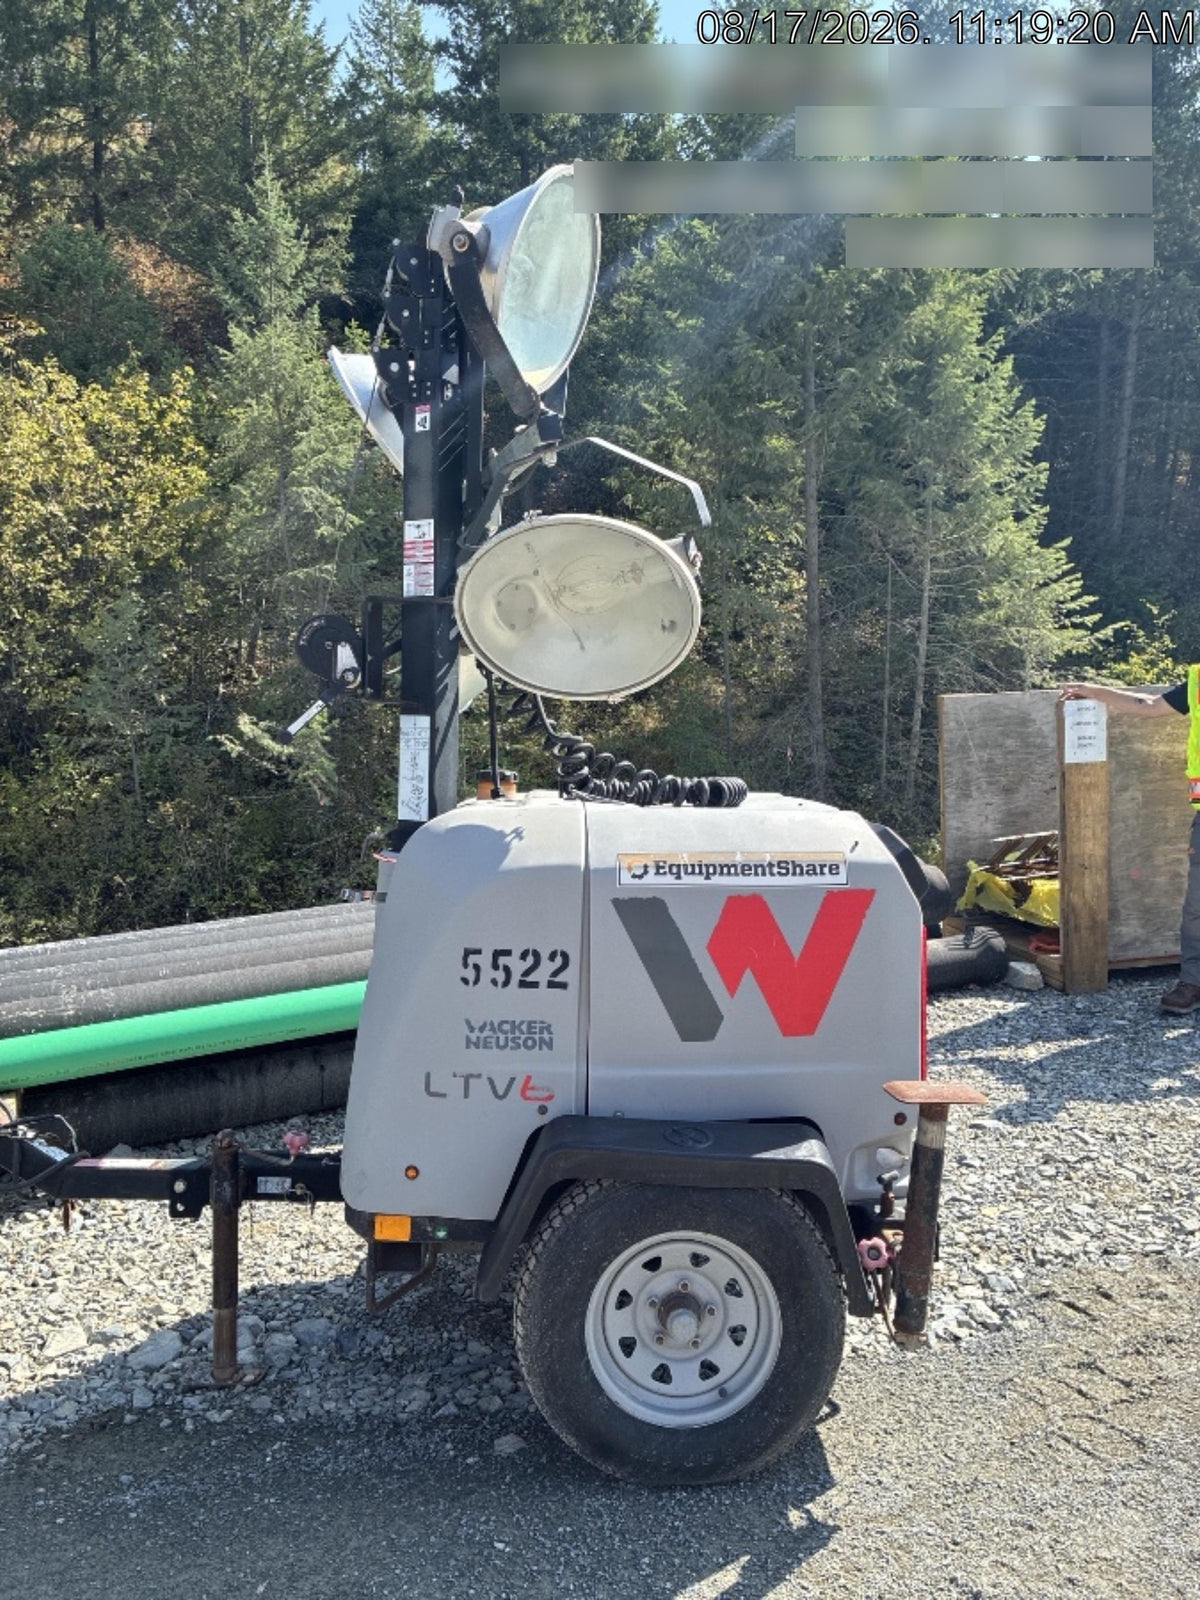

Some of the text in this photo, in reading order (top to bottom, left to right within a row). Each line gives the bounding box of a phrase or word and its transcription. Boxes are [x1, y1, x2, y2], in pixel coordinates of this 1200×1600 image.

[653, 860, 840, 880] EquipmentShare
[460, 947, 570, 990] 5522
[465, 1018, 553, 1035] WACKER
[465, 1035, 553, 1051] NEUSON
